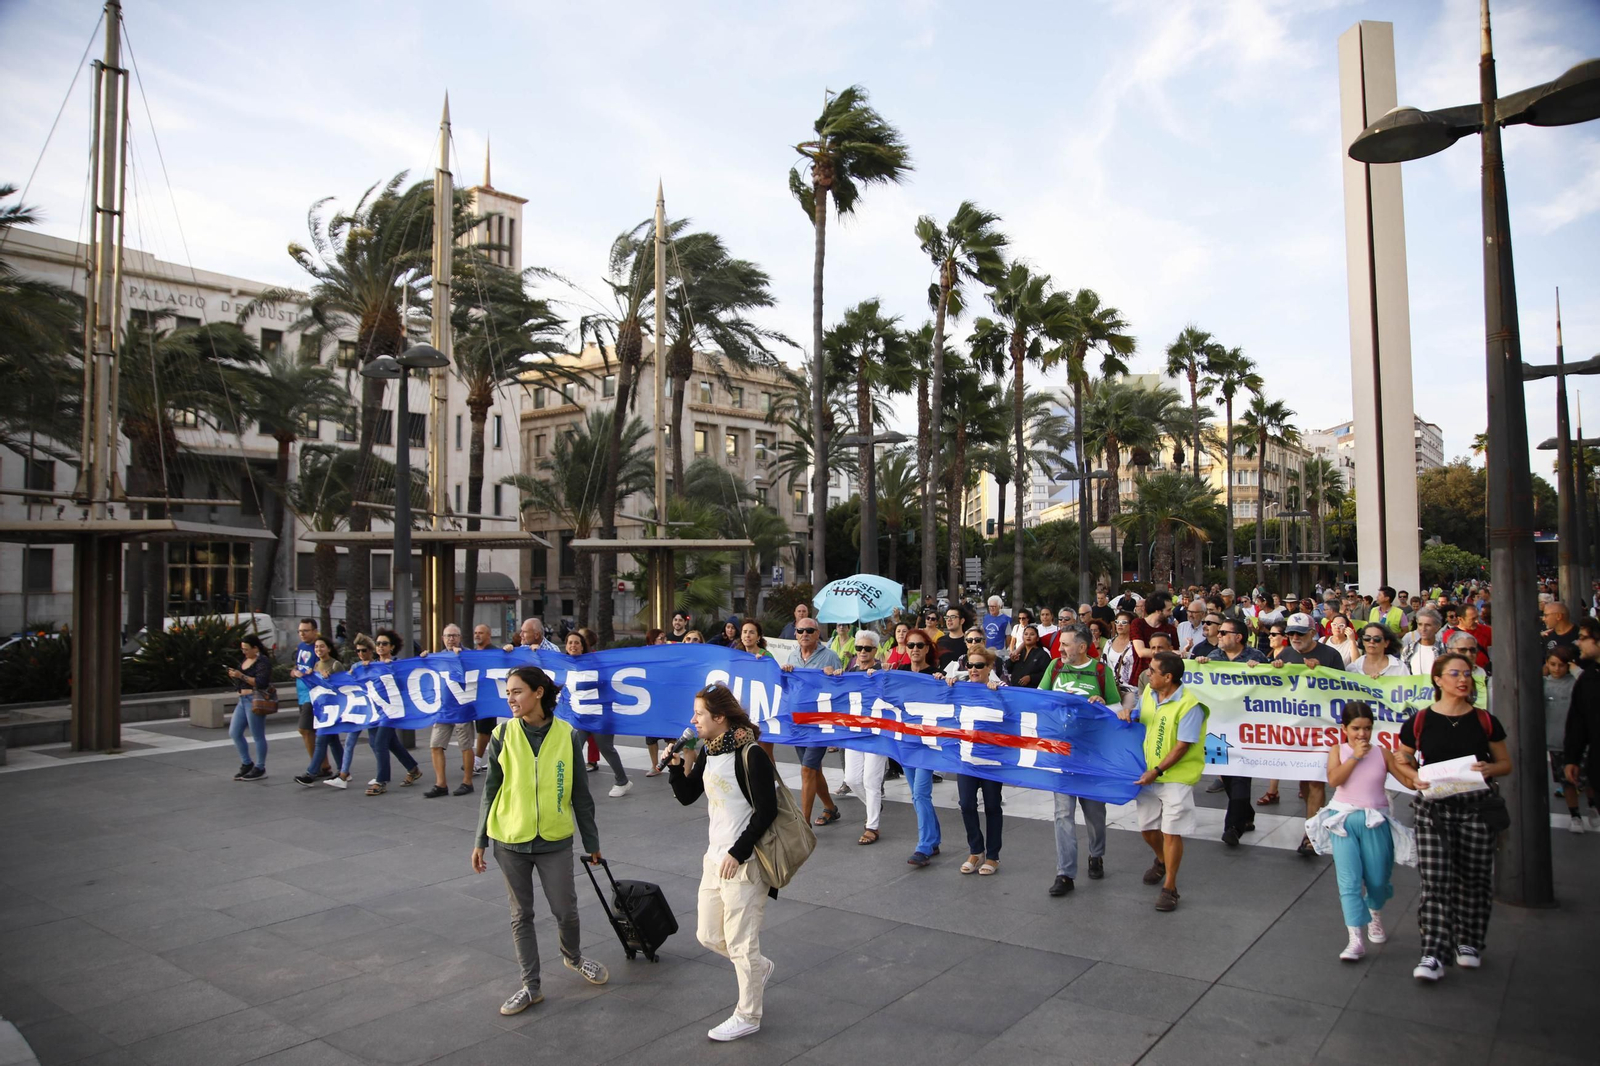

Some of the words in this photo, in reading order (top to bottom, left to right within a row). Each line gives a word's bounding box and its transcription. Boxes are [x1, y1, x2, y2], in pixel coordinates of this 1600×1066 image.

[129, 286, 206, 308] PALACIO
[221, 300, 243, 314] DE
[1181, 671, 1204, 685] os
[1209, 671, 1284, 687] vecinos
[1287, 675, 1300, 692] y
[309, 665, 652, 730] GENOVES
[1243, 695, 1322, 717] también
[1238, 723, 1348, 747] GENOVES
[1238, 757, 1287, 768] Asociación
